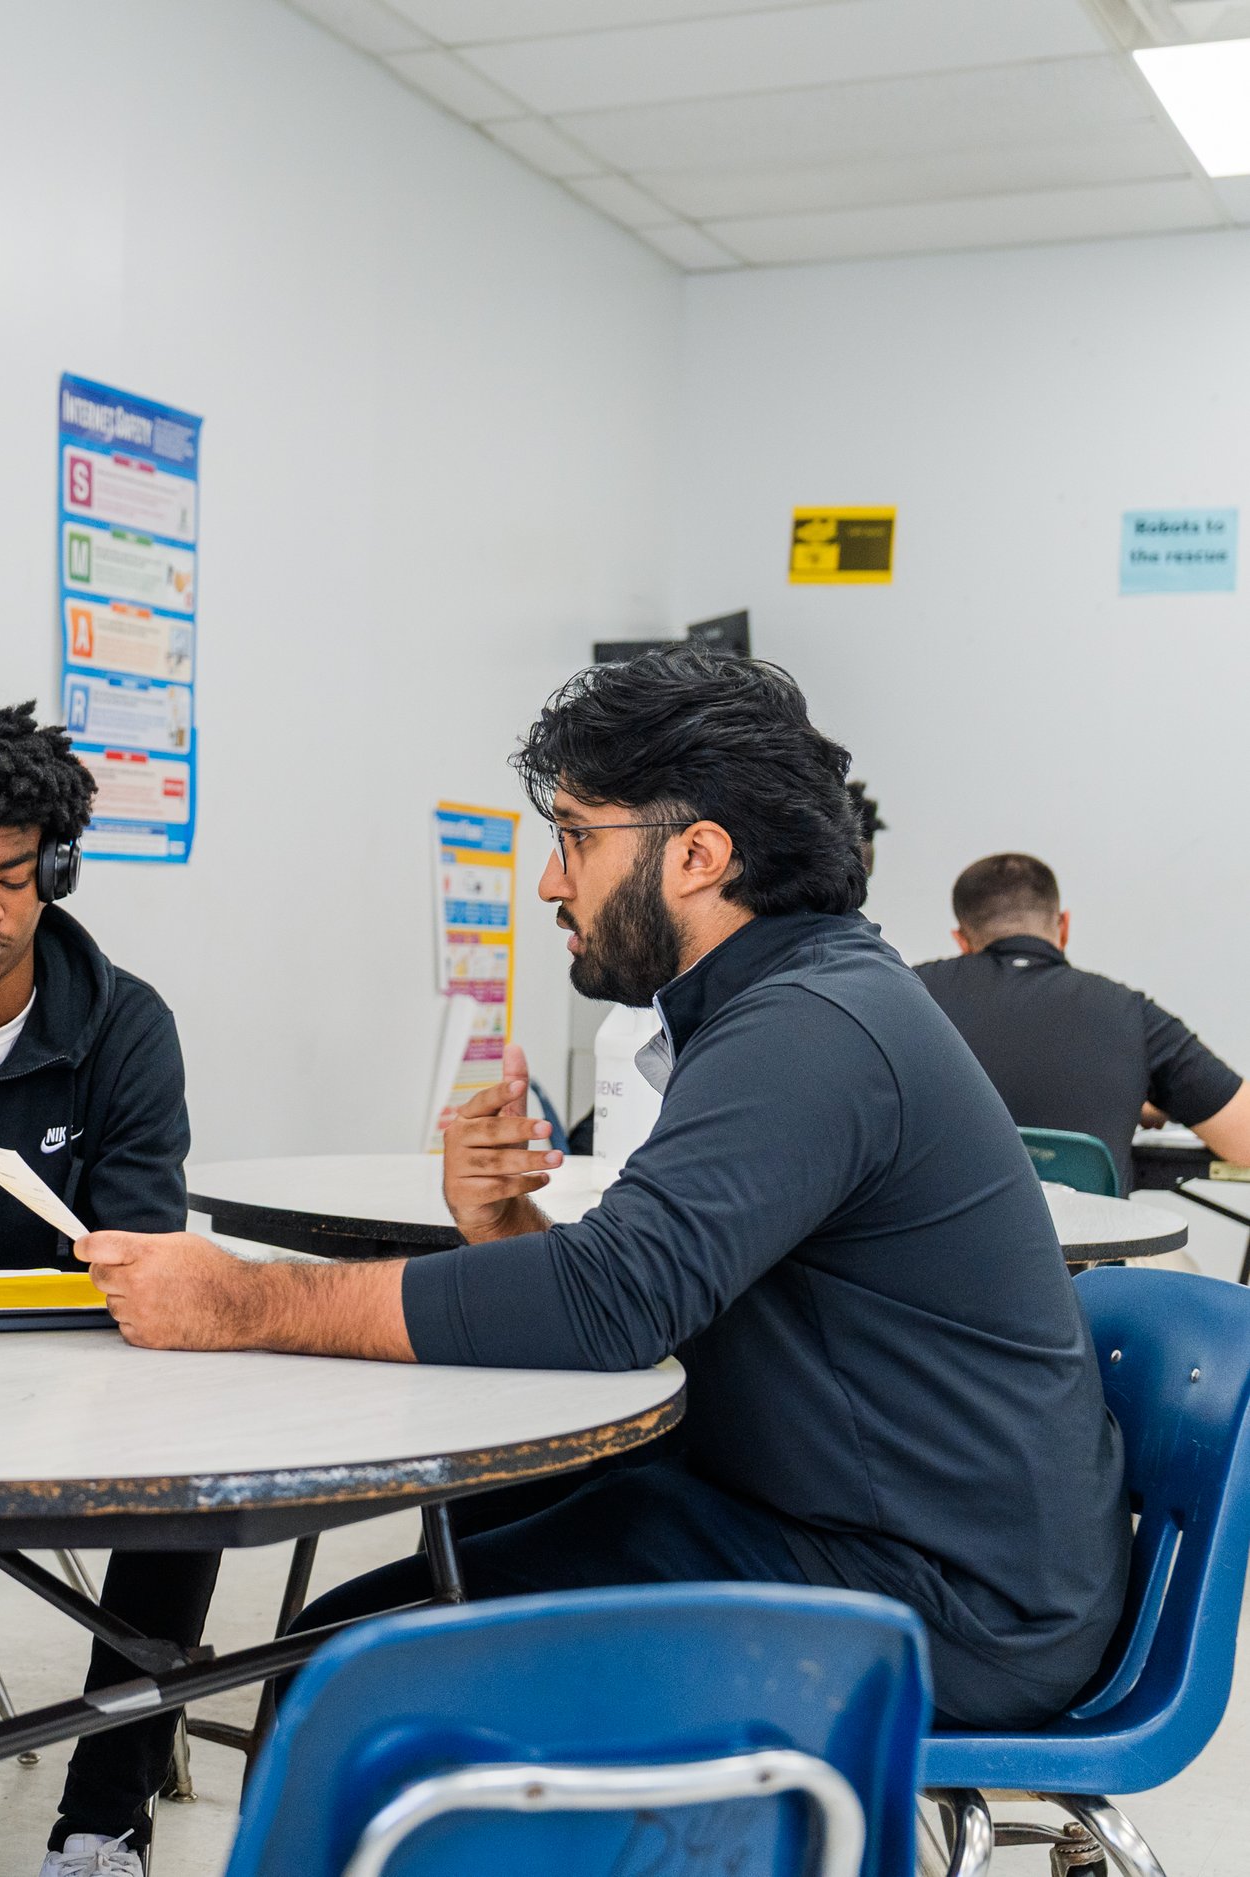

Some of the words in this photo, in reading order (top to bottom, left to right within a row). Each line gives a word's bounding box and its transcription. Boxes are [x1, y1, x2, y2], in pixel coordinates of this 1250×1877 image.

[62, 388, 115, 440] INTERNET
[114, 405, 153, 447] SAFETY
[72, 462, 90, 501] S
[1135, 518, 1199, 534] Robots
[1205, 518, 1225, 532] to
[1130, 549, 1159, 563] the
[1165, 551, 1228, 564] rescue
[75, 614, 90, 652] A
[71, 689, 87, 727] R
[46, 1125, 71, 1143] NIK
